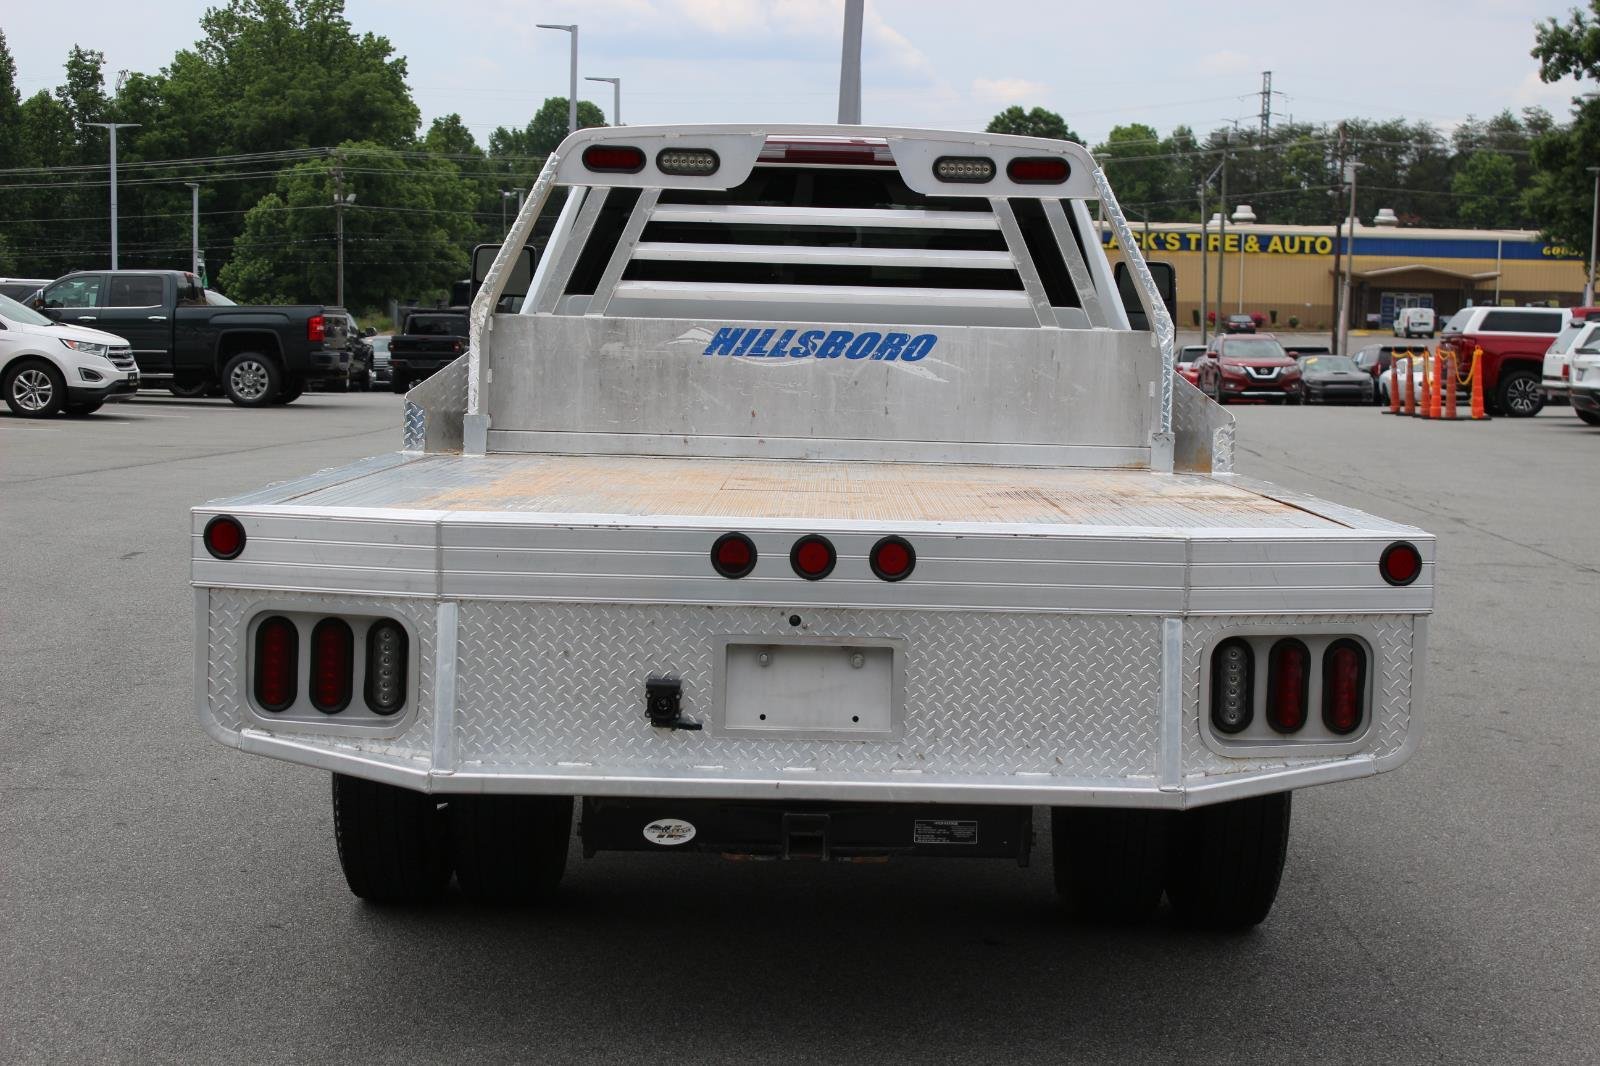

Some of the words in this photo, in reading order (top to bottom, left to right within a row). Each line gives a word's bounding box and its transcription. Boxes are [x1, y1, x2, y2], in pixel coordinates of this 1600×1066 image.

[1103, 231, 1180, 251] AK'S
[1186, 233, 1239, 252] TRE
[1244, 234, 1260, 253] &
[1267, 235, 1332, 254] AUTO
[702, 327, 938, 361] HILLSBORO
